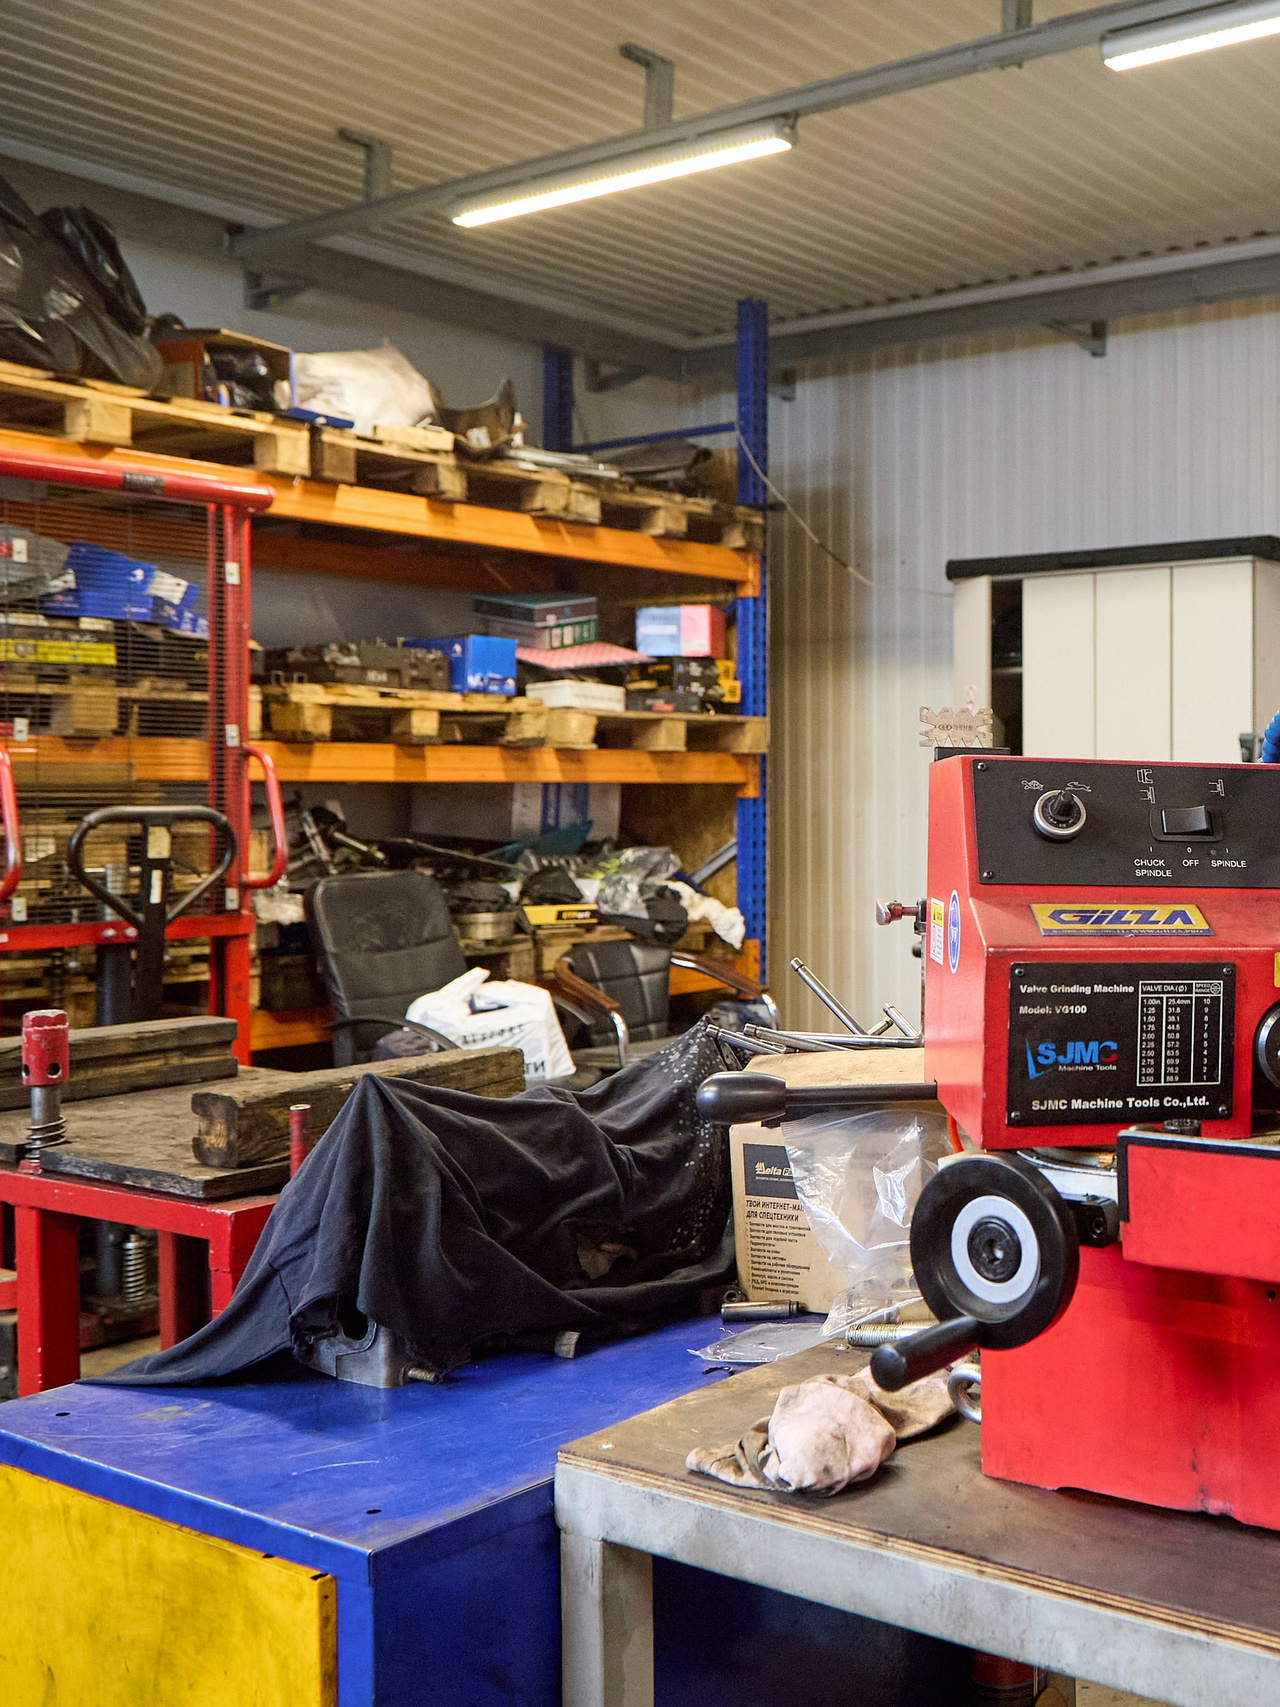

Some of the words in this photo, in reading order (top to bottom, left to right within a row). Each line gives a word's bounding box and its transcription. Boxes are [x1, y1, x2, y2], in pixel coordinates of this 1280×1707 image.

[1134, 859, 1165, 867] CHUCK
[1182, 859, 1200, 867] OFF
[1135, 869, 1172, 877] SPINDLE
[1020, 985, 1047, 993] Valve
[1050, 985, 1091, 995] Grinding
[1094, 984, 1134, 993] Machine
[1019, 1006, 1052, 1014] Model:
[1055, 1005, 1087, 1014] VG100
[1037, 1041, 1118, 1065] SJMC
[1032, 1100, 1067, 1111] SJMC
[1071, 1098, 1123, 1110] Machine
[1127, 1097, 1160, 1108] Tools
[1163, 1096, 1209, 1107] Co.,Ltd.
[746, 1199, 760, 1207] ТВОЙ
[759, 1211, 799, 1221] СПЕЦТЕХНИКИ
